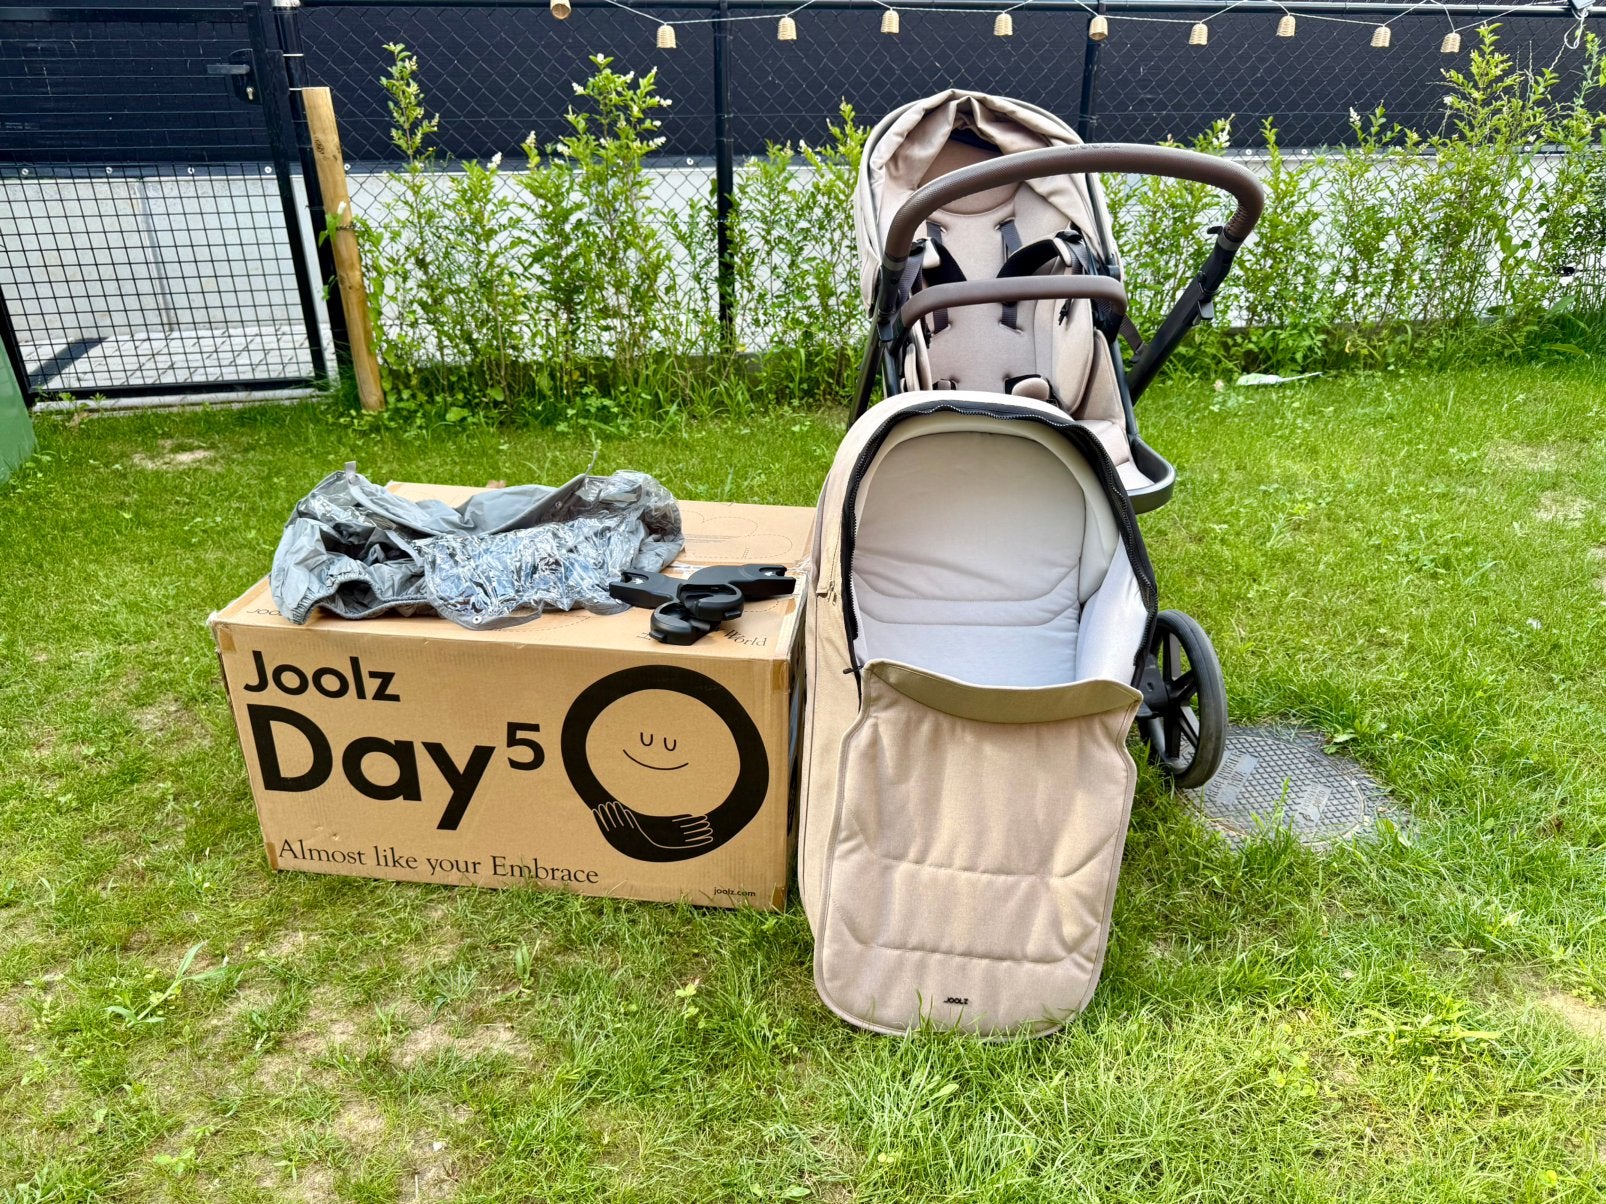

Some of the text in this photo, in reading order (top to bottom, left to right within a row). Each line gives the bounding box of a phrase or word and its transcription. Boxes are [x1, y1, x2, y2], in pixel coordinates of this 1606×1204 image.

[723, 629, 767, 646] World
[243, 650, 401, 702] Joolz
[246, 703, 545, 831] Day 5
[278, 838, 599, 884] Almost like your Embrace
[713, 886, 756, 897] joolz.com
[943, 996, 969, 1005] JOOLZ
